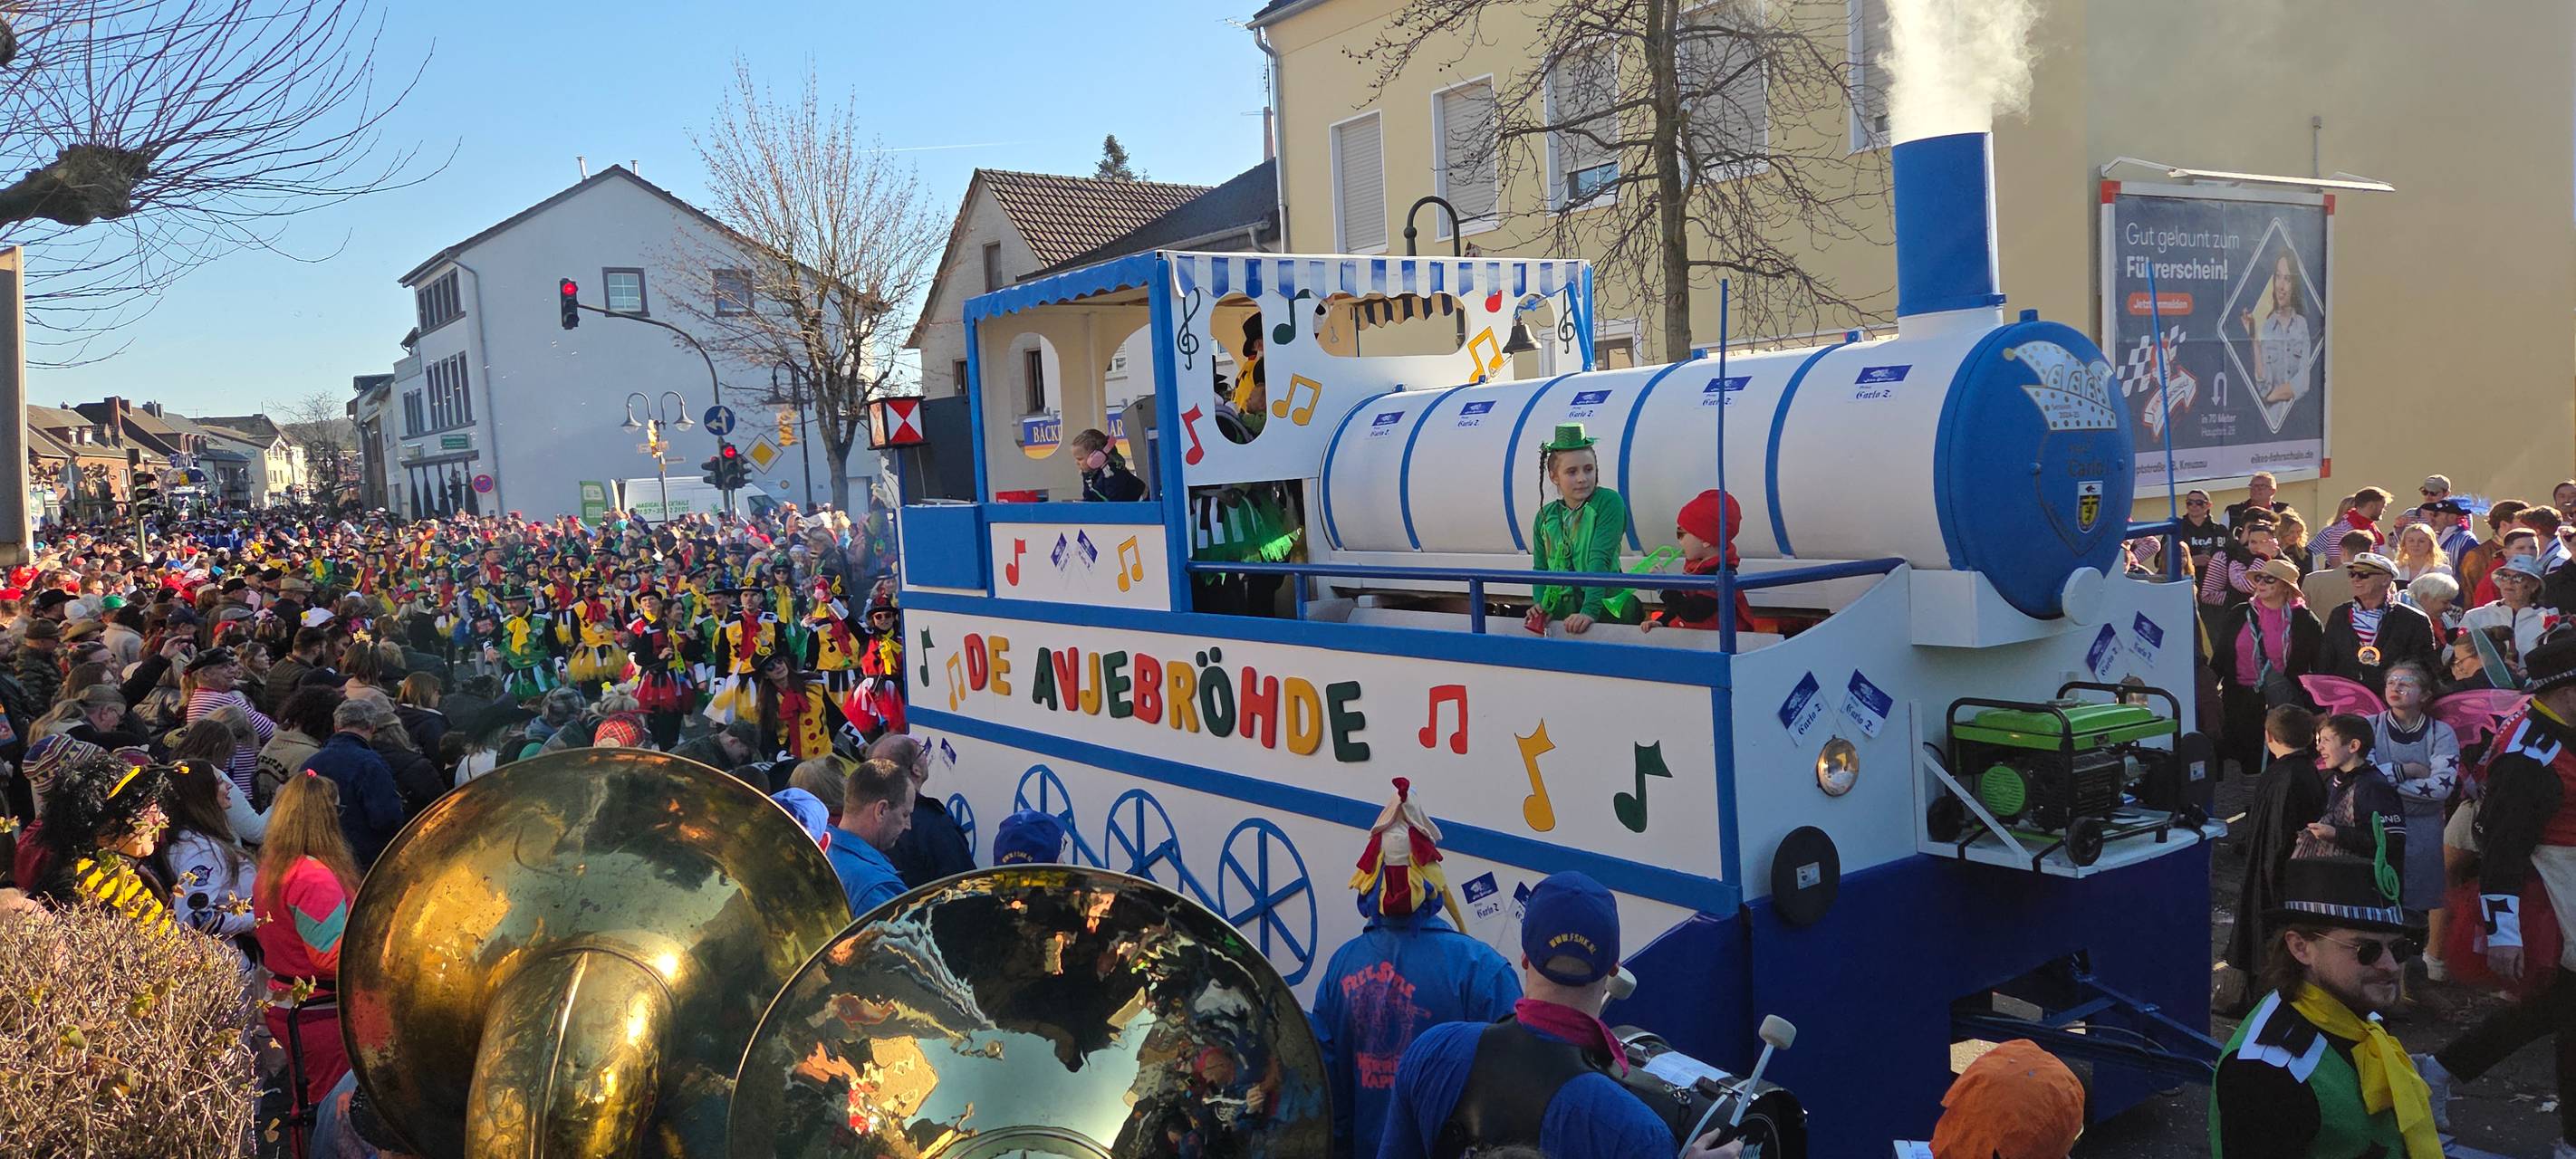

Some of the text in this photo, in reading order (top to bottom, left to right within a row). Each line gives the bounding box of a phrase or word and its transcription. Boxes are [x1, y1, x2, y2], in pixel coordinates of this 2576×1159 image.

[2126, 222, 2240, 254] Gut gelaunt zum
[2156, 300, 2188, 309] nmelden
[964, 633, 1371, 763] DE AVJEBRÖHDE
